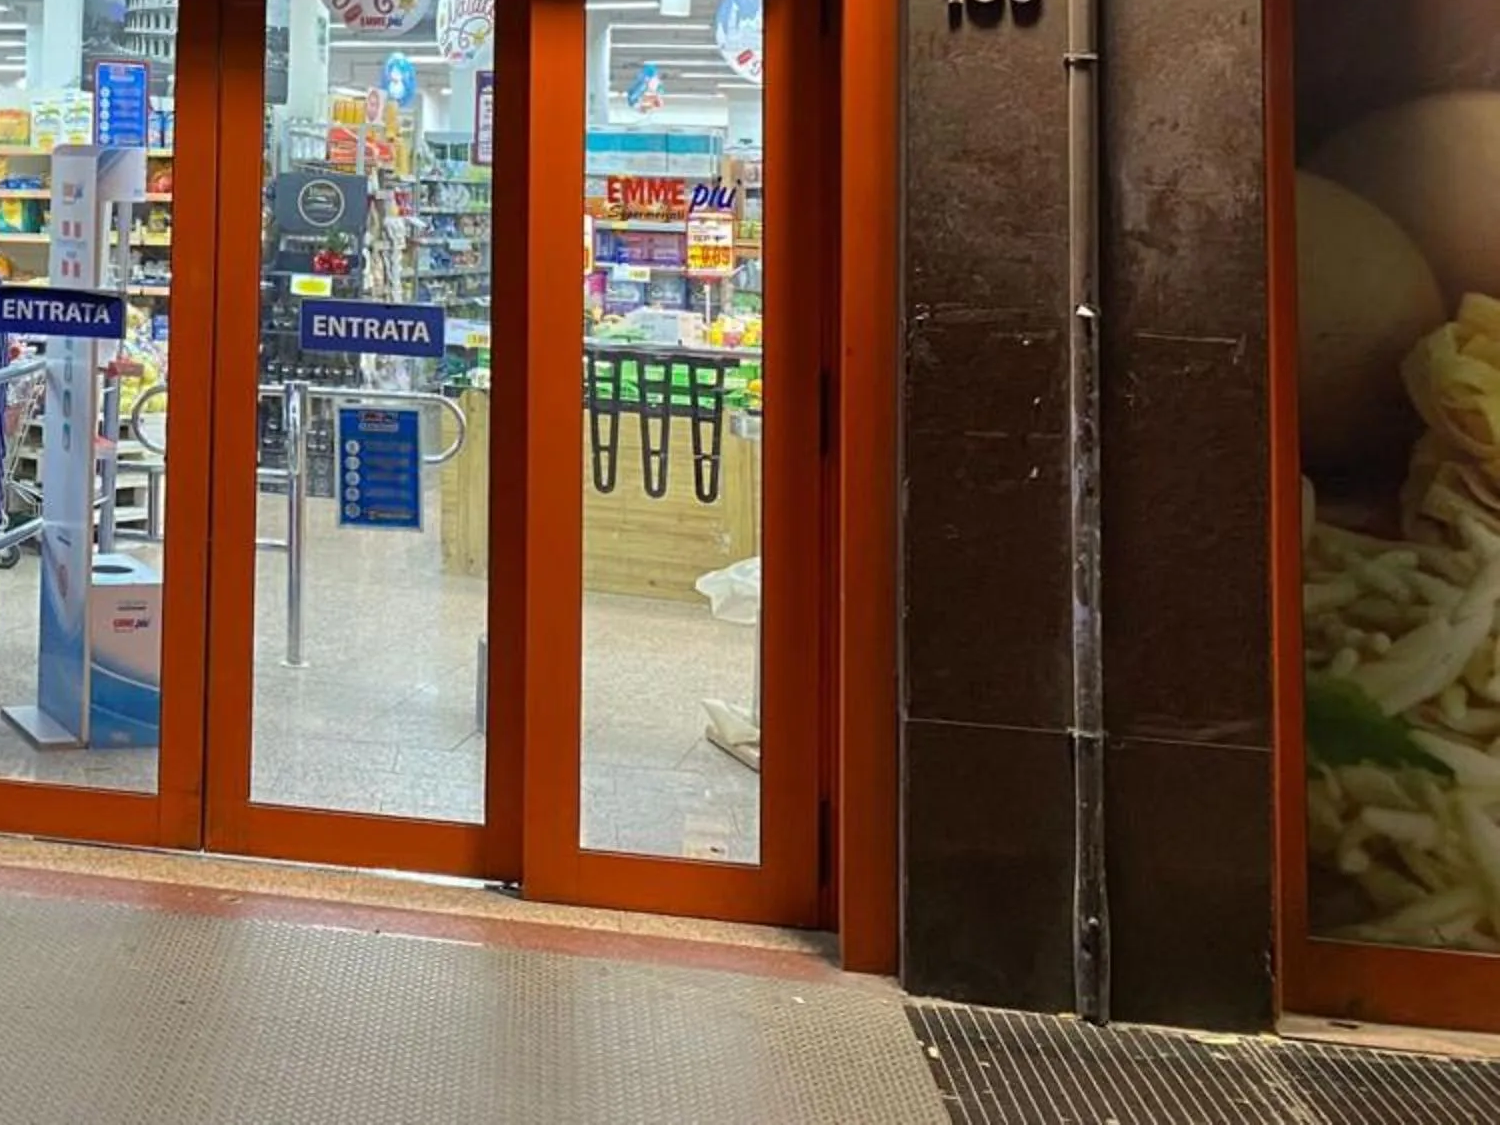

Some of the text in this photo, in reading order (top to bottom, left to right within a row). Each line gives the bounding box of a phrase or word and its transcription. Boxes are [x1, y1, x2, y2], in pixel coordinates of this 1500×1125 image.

[607, 176, 686, 205] EMME
[2, 298, 111, 324] ENTRATA
[311, 314, 431, 344] ENTRATA
